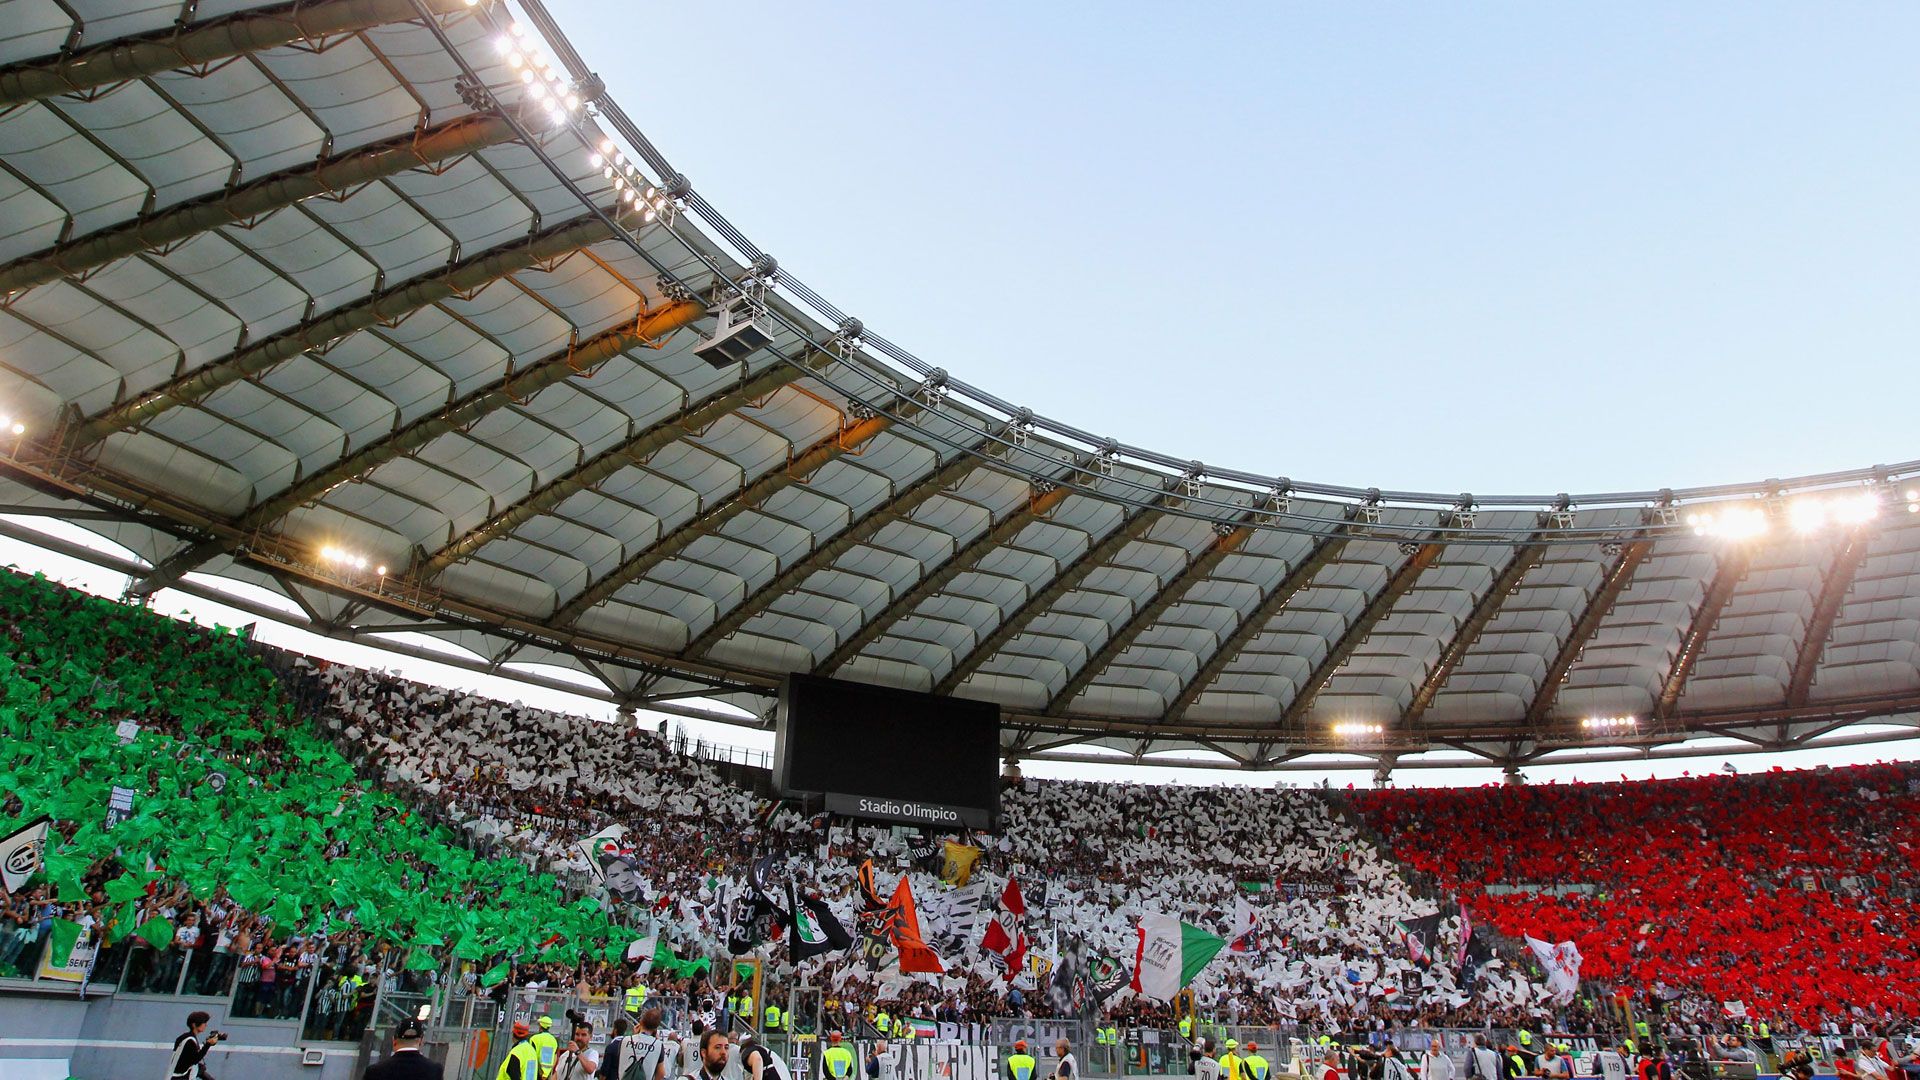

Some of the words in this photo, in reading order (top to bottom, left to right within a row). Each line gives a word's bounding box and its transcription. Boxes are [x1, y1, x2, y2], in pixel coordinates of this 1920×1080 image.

[859, 798, 900, 815] Stadio
[902, 803, 957, 821] Olimpico
[626, 1040, 655, 1052] PHOTO
[1608, 1062, 1620, 1072] 119
